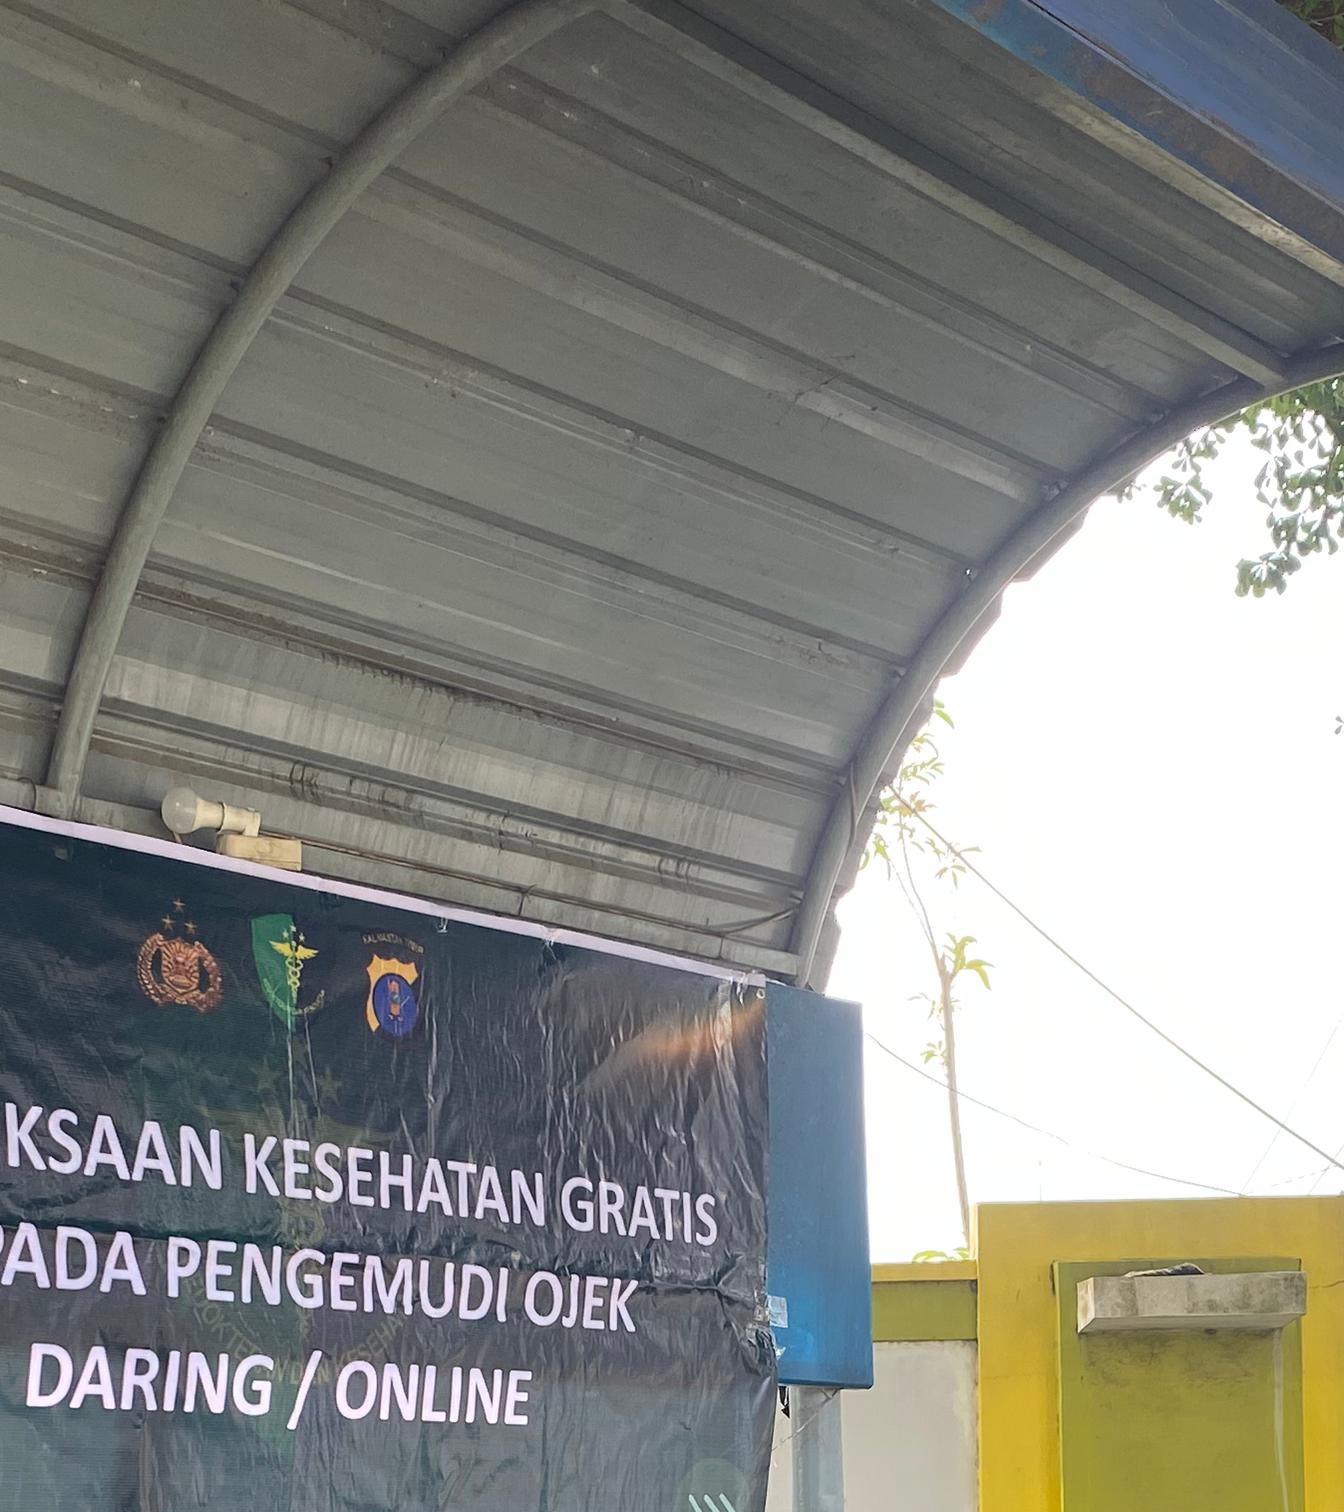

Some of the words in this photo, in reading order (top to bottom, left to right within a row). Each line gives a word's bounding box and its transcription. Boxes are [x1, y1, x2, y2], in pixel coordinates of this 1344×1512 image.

[243, 1133, 545, 1227] KESEHATAN
[561, 1172, 718, 1246] GRATIS
[167, 1236, 509, 1323] PENGEMUDI
[524, 1271, 639, 1333] OJEK
[25, 1342, 275, 1416] DARING
[286, 1350, 323, 1431] /
[335, 1360, 533, 1426] ONLINE
